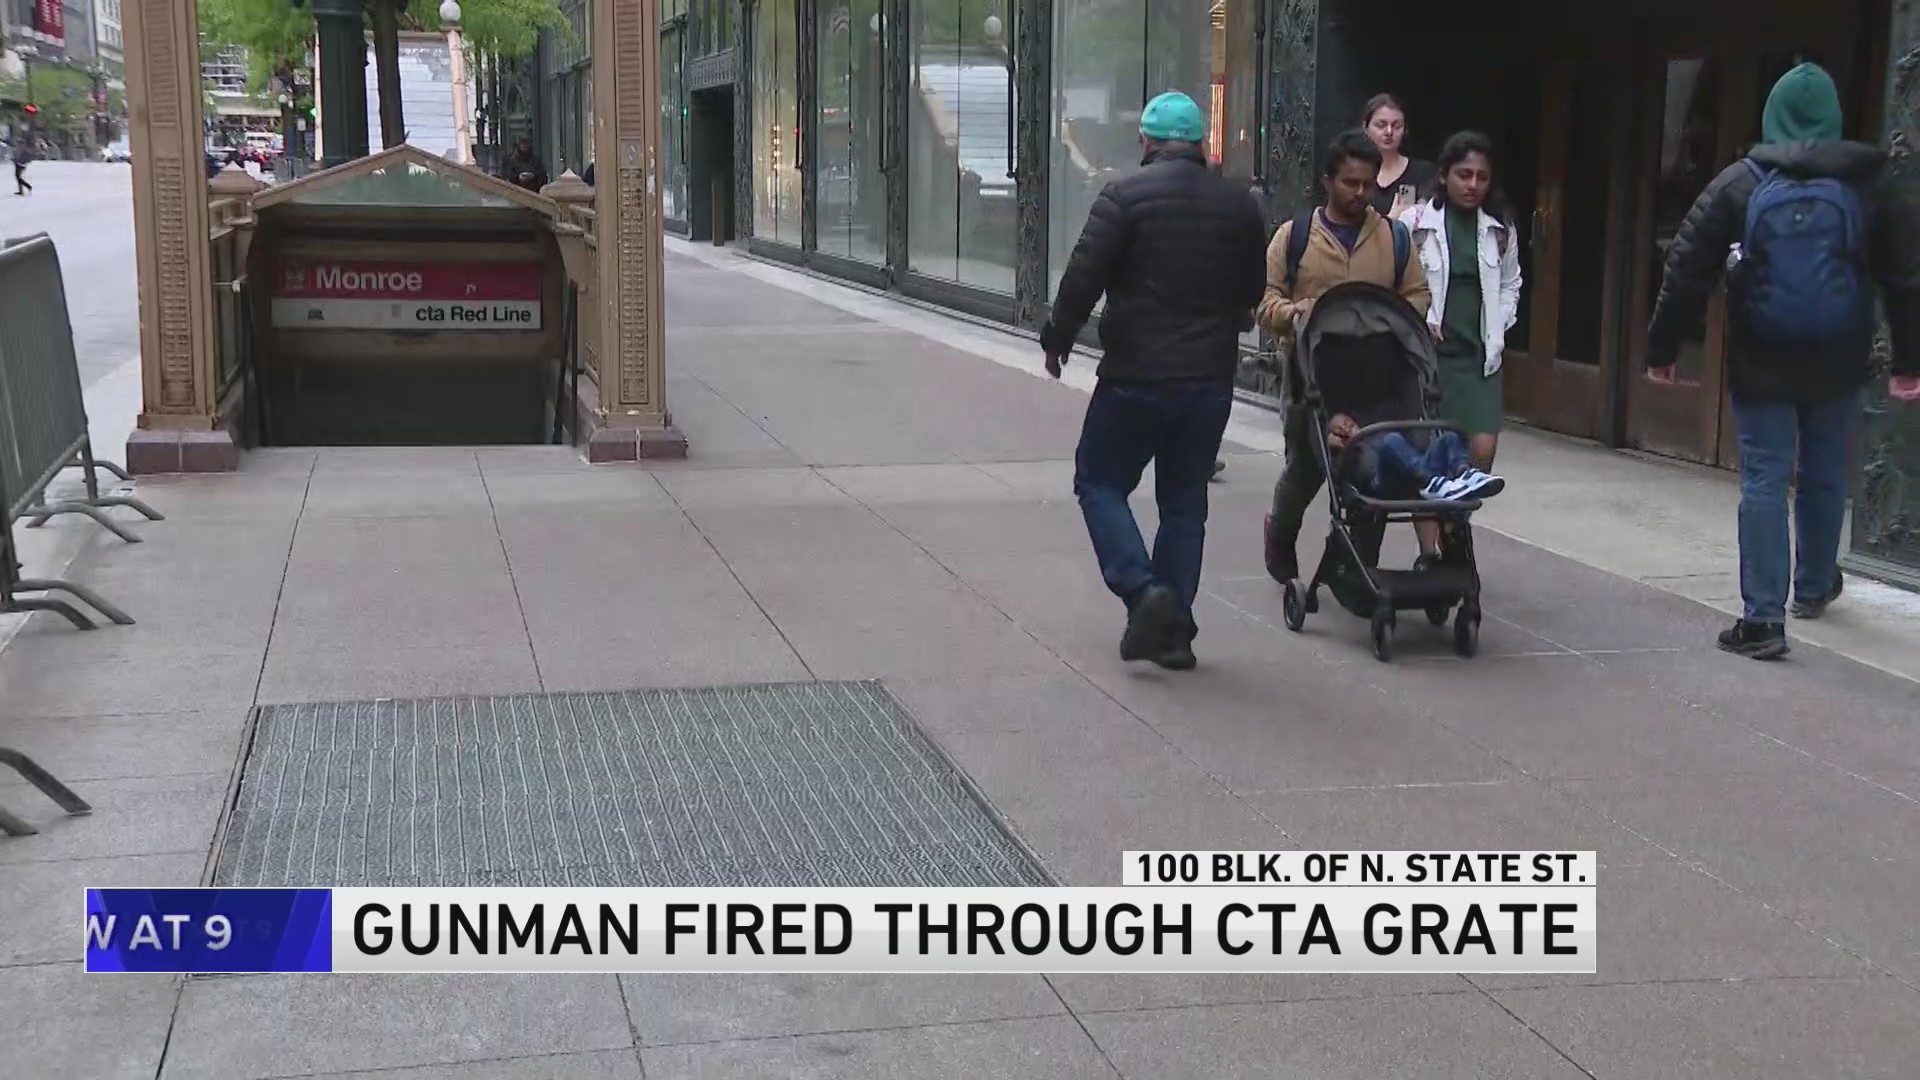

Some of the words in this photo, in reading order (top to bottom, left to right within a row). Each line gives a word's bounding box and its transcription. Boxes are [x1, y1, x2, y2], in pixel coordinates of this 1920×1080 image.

[315, 265, 423, 292] Monroe
[415, 305, 445, 323] cta
[450, 305, 487, 323] Red
[492, 305, 532, 323] Line
